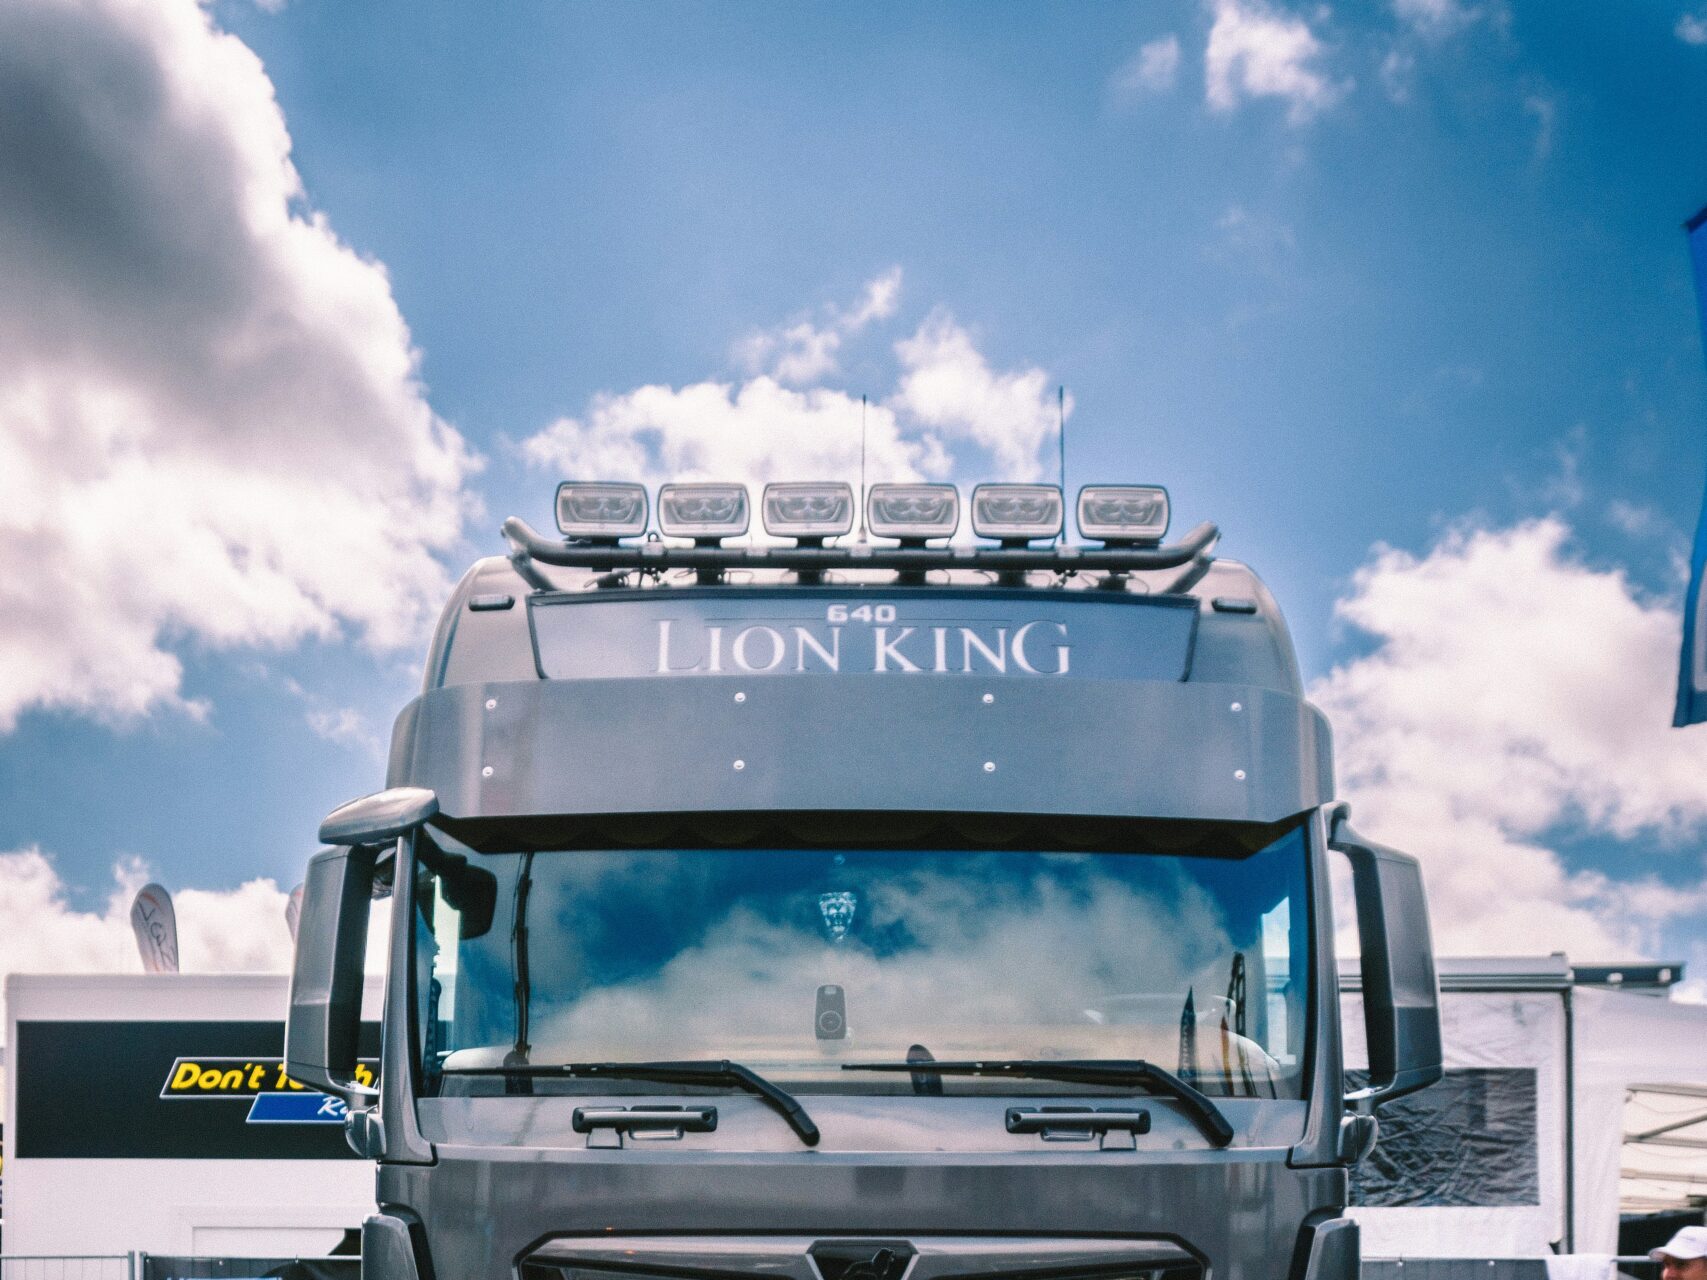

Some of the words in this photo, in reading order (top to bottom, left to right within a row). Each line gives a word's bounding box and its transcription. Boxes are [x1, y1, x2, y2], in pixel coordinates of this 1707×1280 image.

[827, 604, 897, 623] 640
[654, 618, 841, 674] LION
[872, 620, 1075, 675] KING
[171, 1063, 265, 1089] Don't
